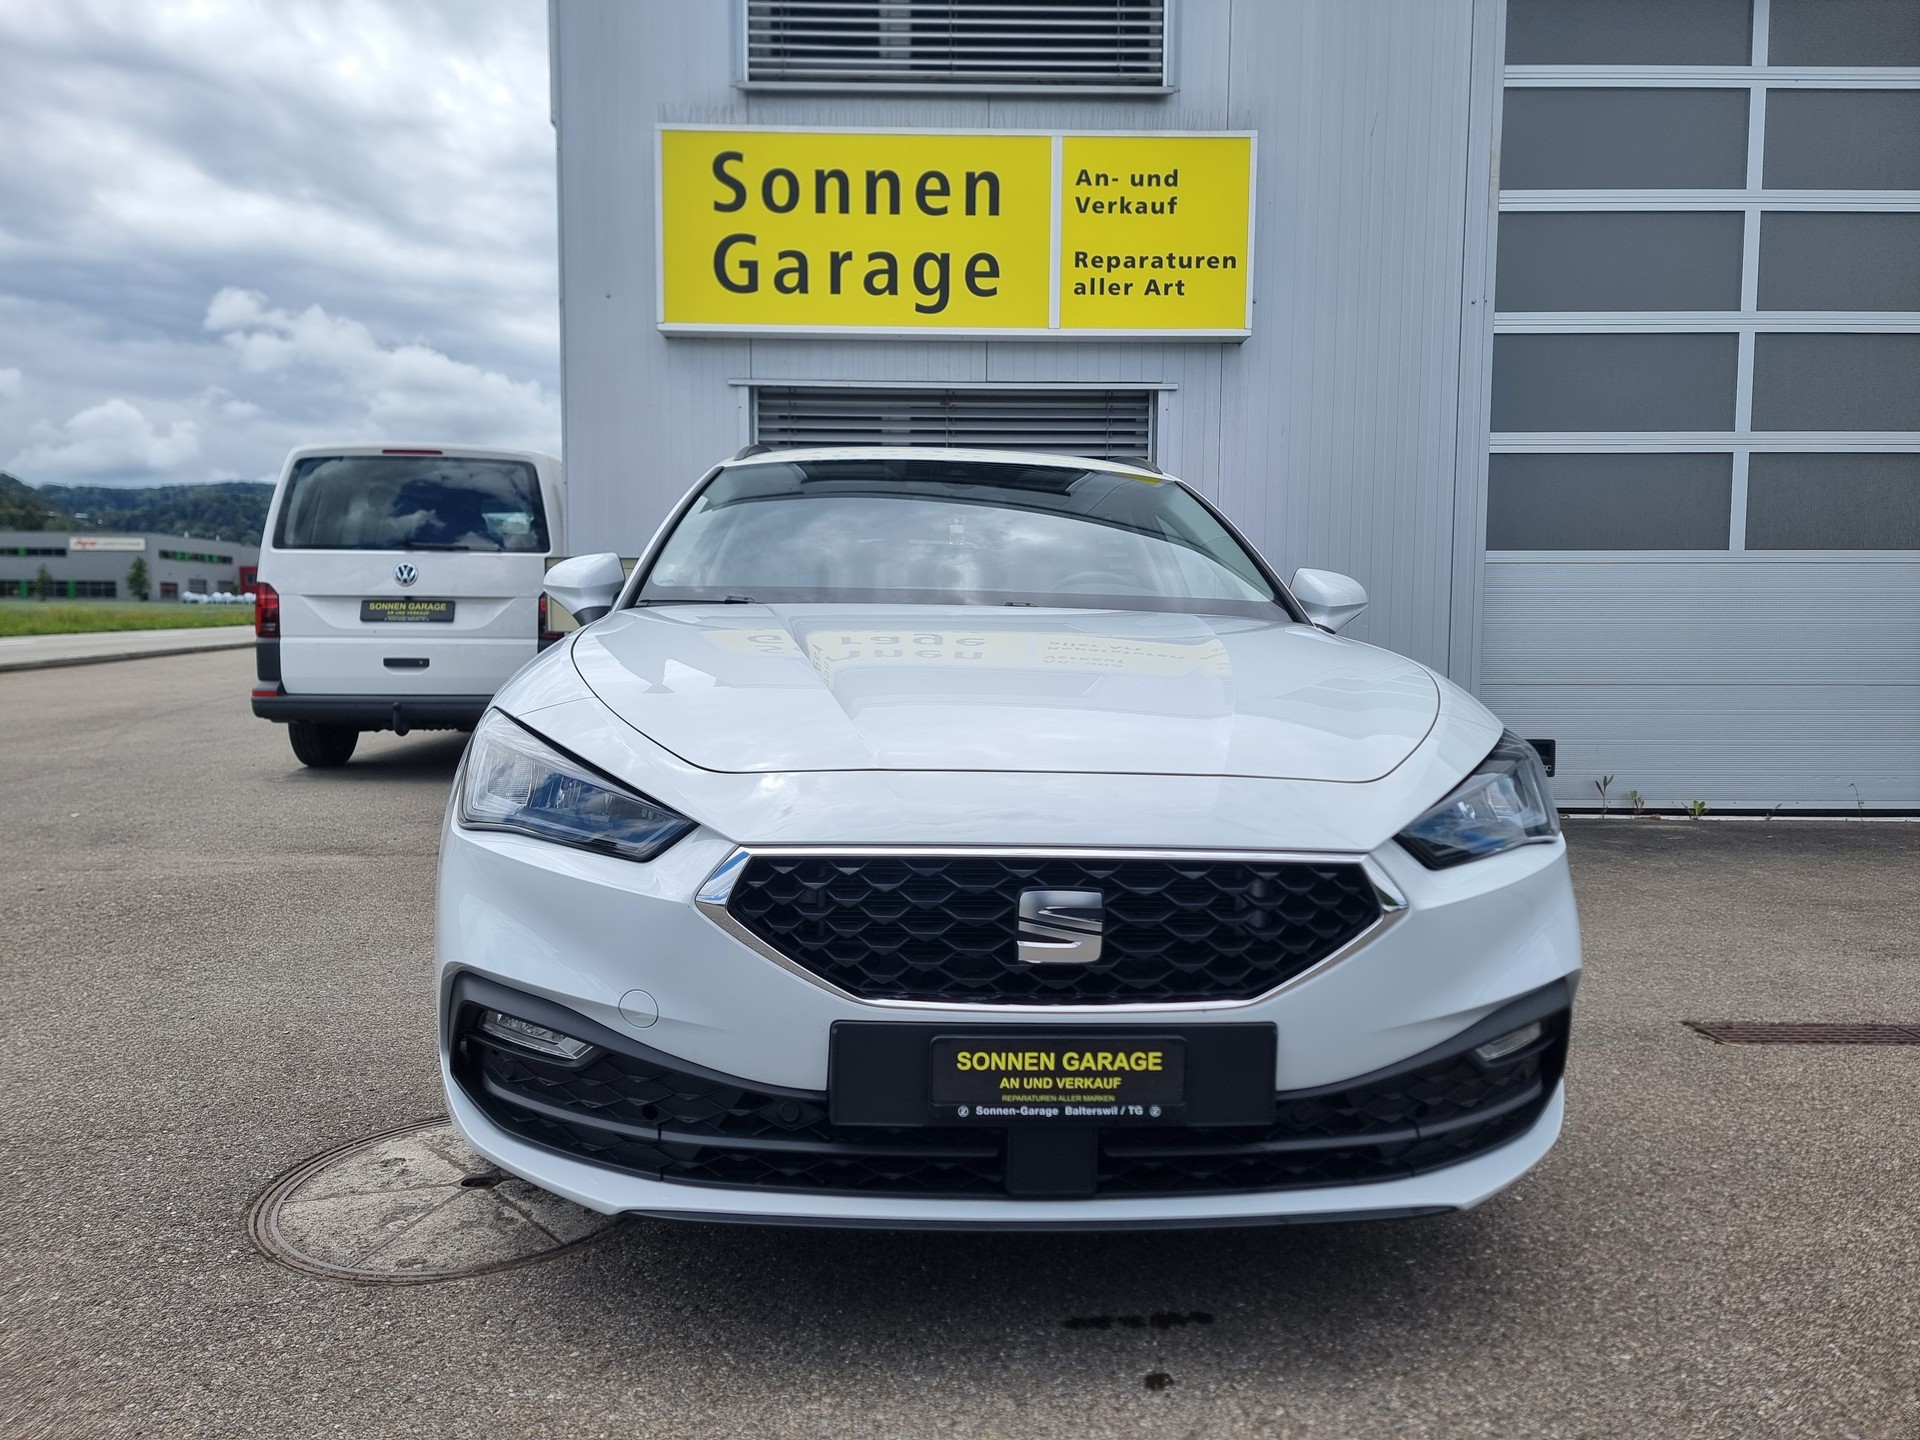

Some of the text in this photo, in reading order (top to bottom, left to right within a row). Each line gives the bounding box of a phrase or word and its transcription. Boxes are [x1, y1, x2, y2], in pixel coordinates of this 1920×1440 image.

[711, 150, 1001, 217] Sonnen
[1075, 168, 1179, 188] An- und
[1074, 195, 1178, 215] Verkauf
[1074, 251, 1238, 274] Reparaturen
[712, 232, 1001, 315] Garage
[1073, 277, 1186, 296] aller Art
[369, 602, 447, 611] SONNEN GARAGE
[956, 1051, 1163, 1071] SONNEN GARAGE
[999, 1077, 1122, 1089] AN UND VERKAUF
[1001, 1094, 1116, 1102] REPARATUREN ALLER MARKEN
[975, 1105, 1059, 1117] Sonnen-Garage
[1064, 1105, 1118, 1115] Balterswil
[1128, 1105, 1144, 1115] TG
